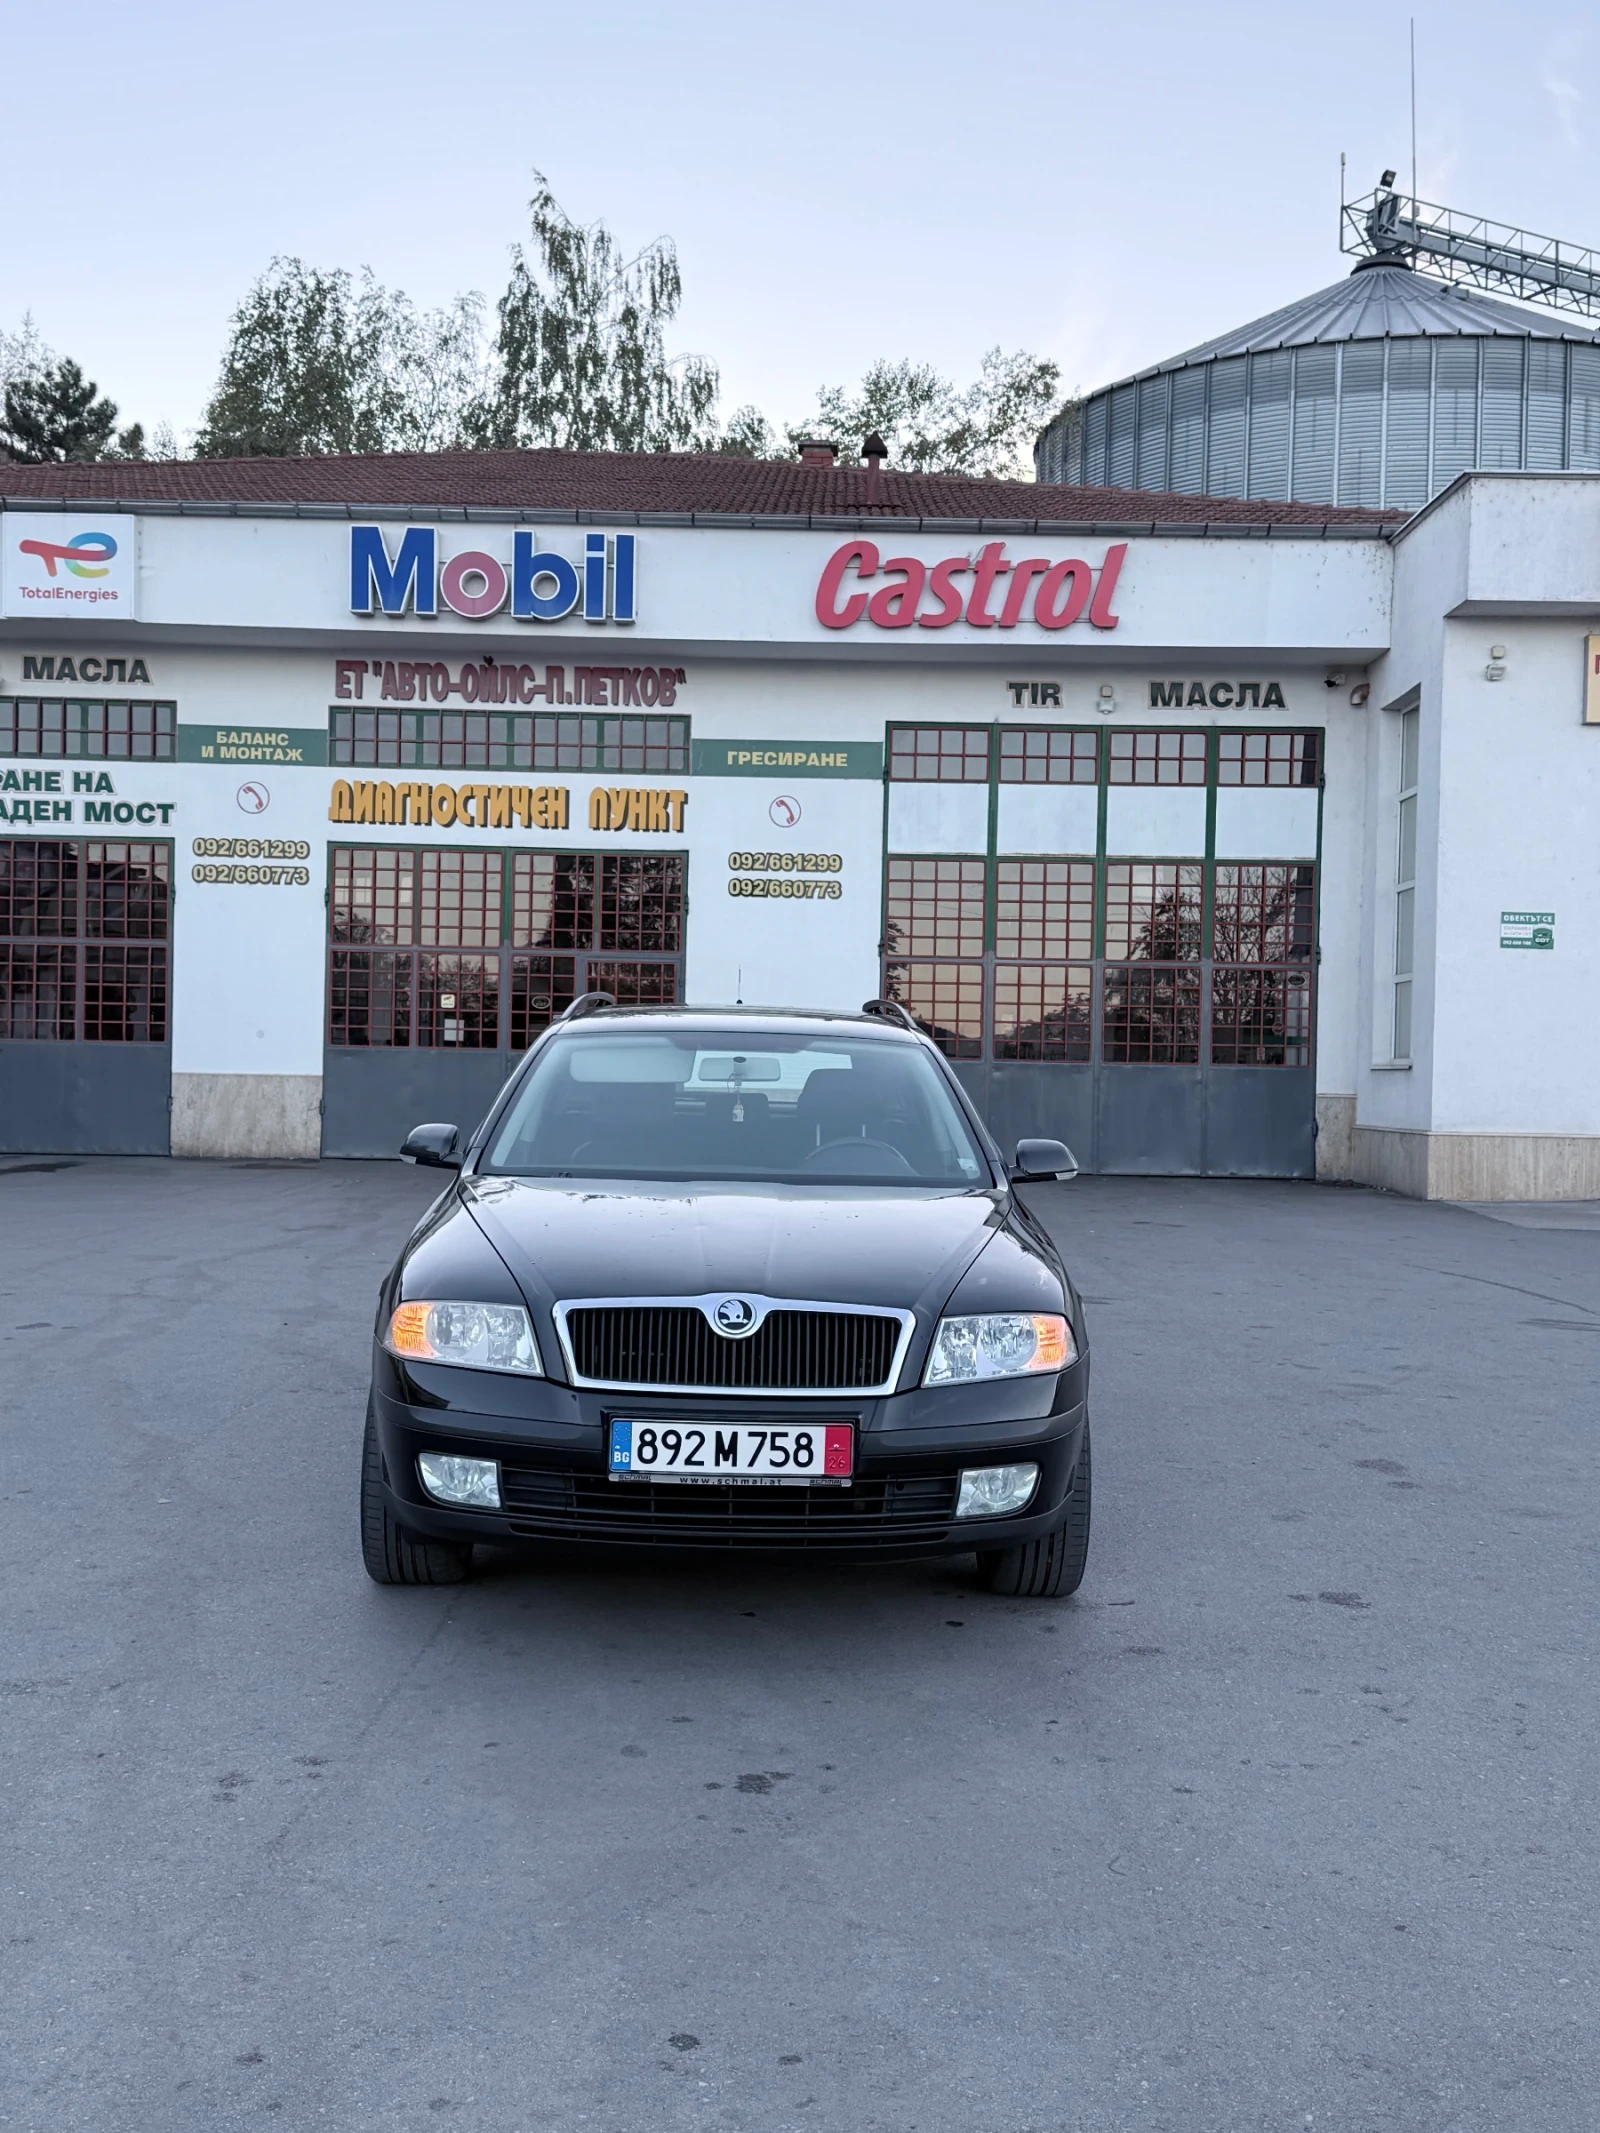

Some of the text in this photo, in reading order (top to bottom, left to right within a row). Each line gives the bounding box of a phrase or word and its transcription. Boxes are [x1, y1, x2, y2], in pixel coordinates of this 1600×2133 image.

[349, 525, 637, 624] Mobil
[815, 540, 1128, 629] Castrol
[19, 586, 118, 603] TotalEnergies
[22, 655, 153, 685] МАСЛА
[335, 660, 368, 699] ЕТ
[1007, 682, 1063, 708] TIR
[1148, 682, 1288, 711] МАСЛА
[216, 731, 289, 746] БАЛАНС
[201, 746, 303, 761] И МОНТАЖ
[727, 751, 848, 767] ГРЕСИРАНЕ
[0, 770, 115, 793] АНЕ НА
[84, 801, 175, 825] МОСТ
[329, 779, 689, 833] ДИАГНОСТИЧЕН ПУНКТ
[193, 838, 310, 860] 092/661299
[728, 852, 843, 873] 092/661299
[192, 864, 309, 885] 092/660773
[728, 878, 842, 899] 092/660773
[1542, 915, 1553, 923] СЕ
[613, 1451, 630, 1463] BG
[637, 1428, 706, 1466] 892
[747, 1432, 814, 1468] 758
[828, 1456, 845, 1469] 26
[680, 1477, 782, 1486] www.schmal.at
